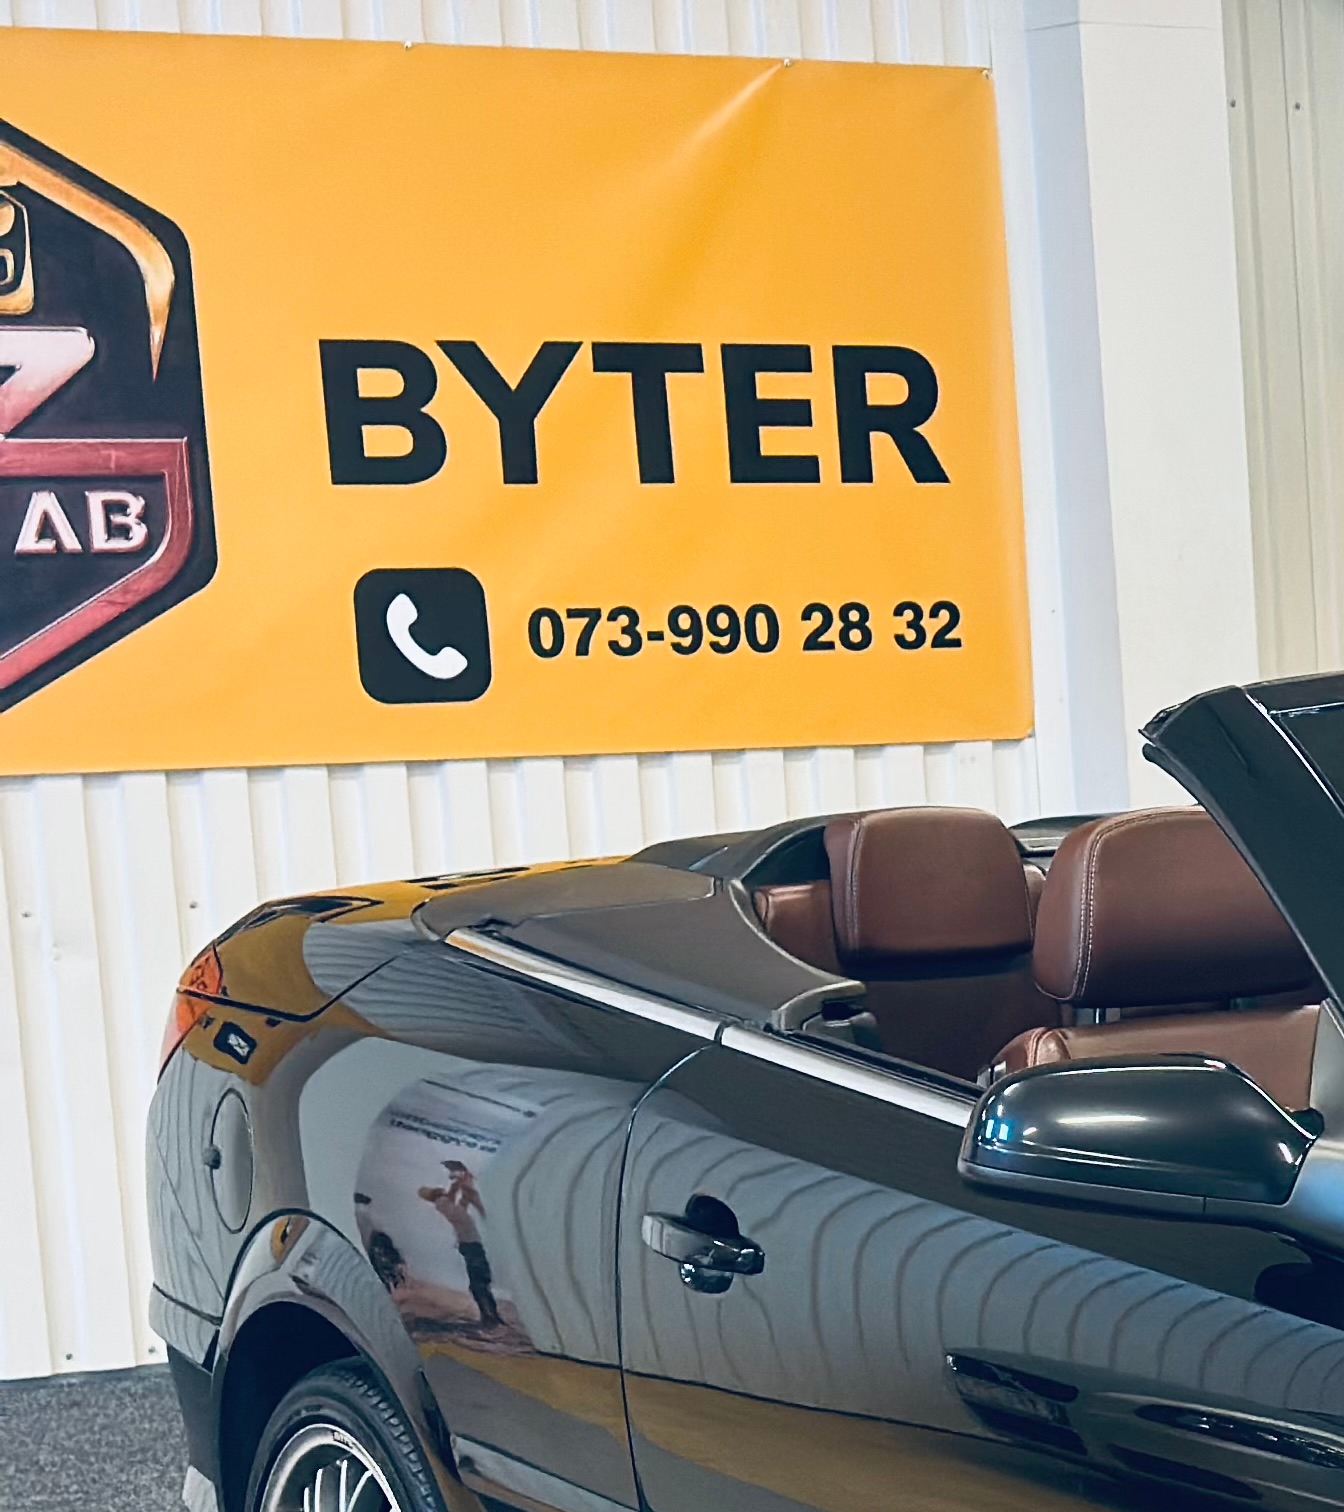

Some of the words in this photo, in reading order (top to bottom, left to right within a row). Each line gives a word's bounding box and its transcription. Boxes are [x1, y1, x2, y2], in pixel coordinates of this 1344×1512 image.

[318, 338, 951, 486] BYTER
[14, 490, 149, 555] AB
[527, 604, 781, 659] 073-990
[800, 602, 874, 653] 28
[893, 600, 962, 651] 32
